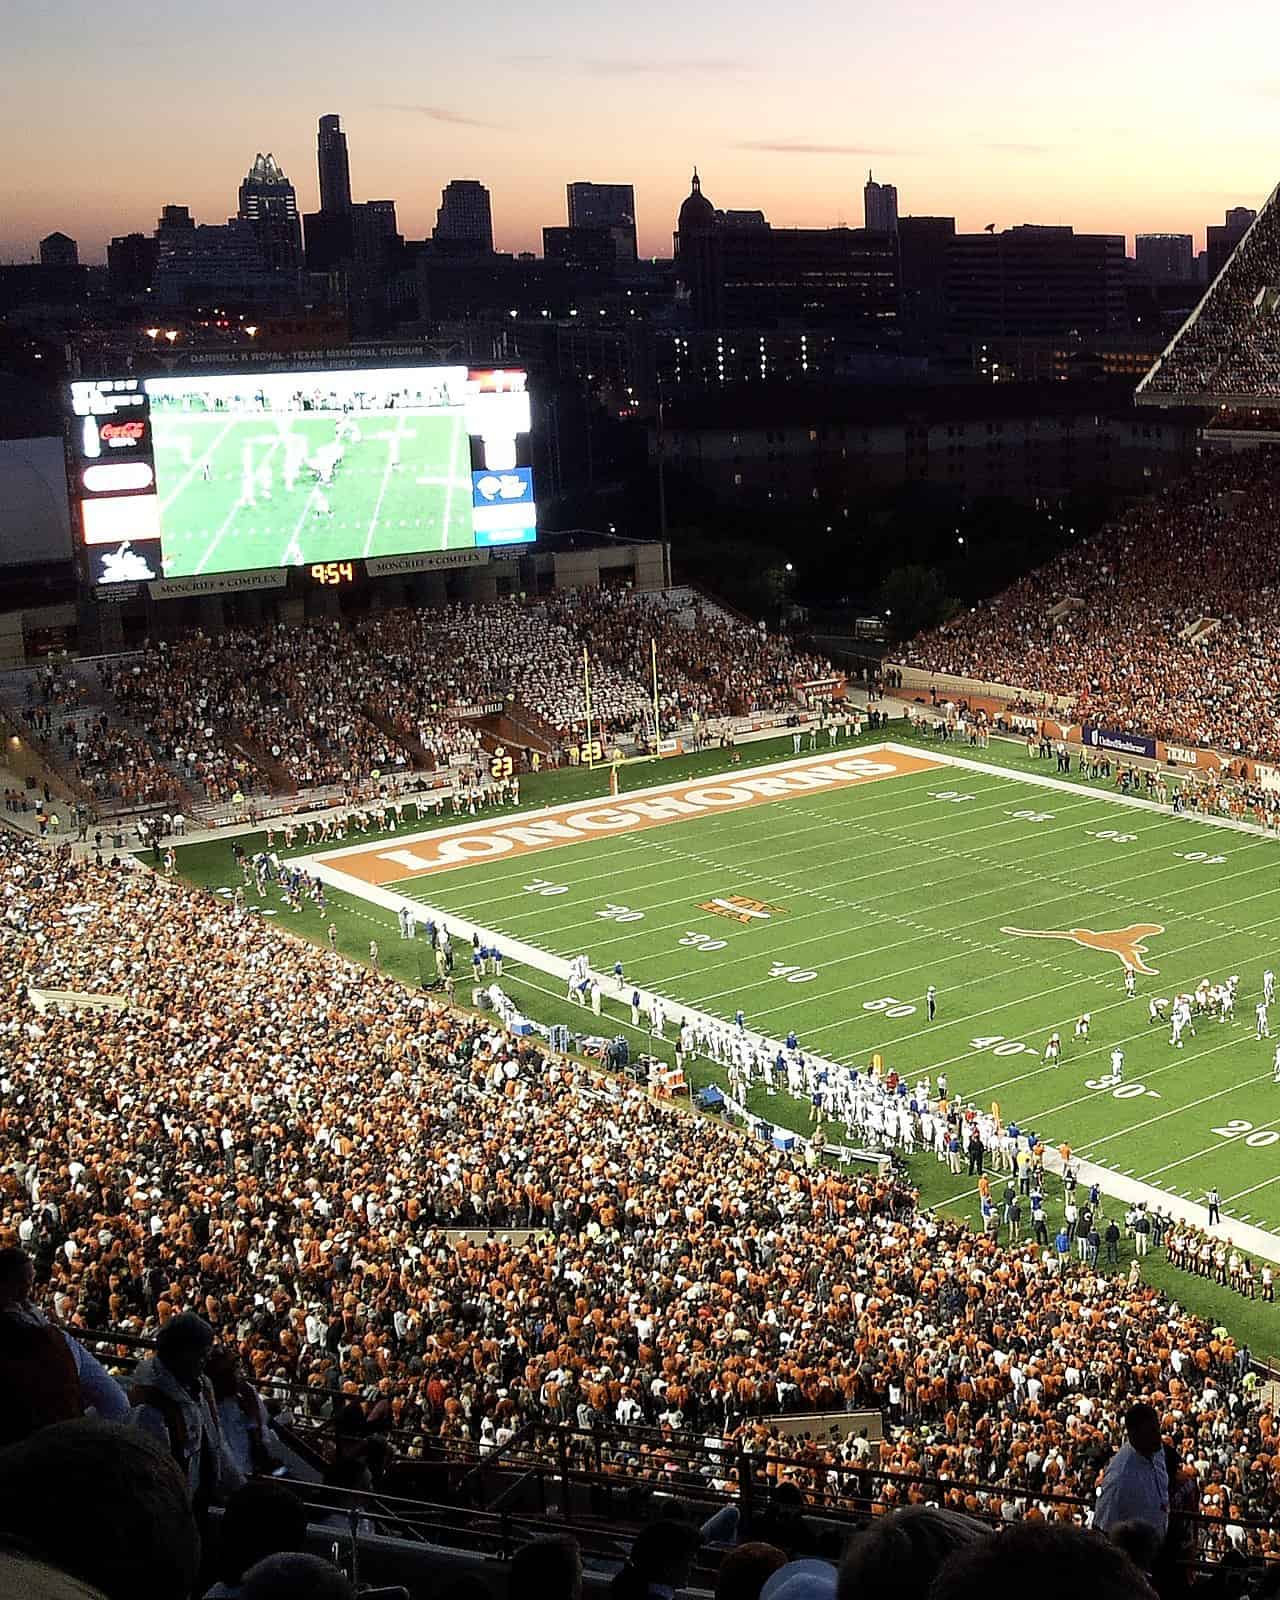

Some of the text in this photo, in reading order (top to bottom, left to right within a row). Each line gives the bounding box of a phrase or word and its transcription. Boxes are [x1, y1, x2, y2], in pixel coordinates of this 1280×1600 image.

[310, 562, 353, 585] 9:54
[1166, 746, 1197, 764] TEXAS
[491, 756, 513, 778] 23
[375, 757, 899, 872] LONGHORNS
[862, 996, 917, 1019] 50
[968, 1035, 1026, 1057] 40
